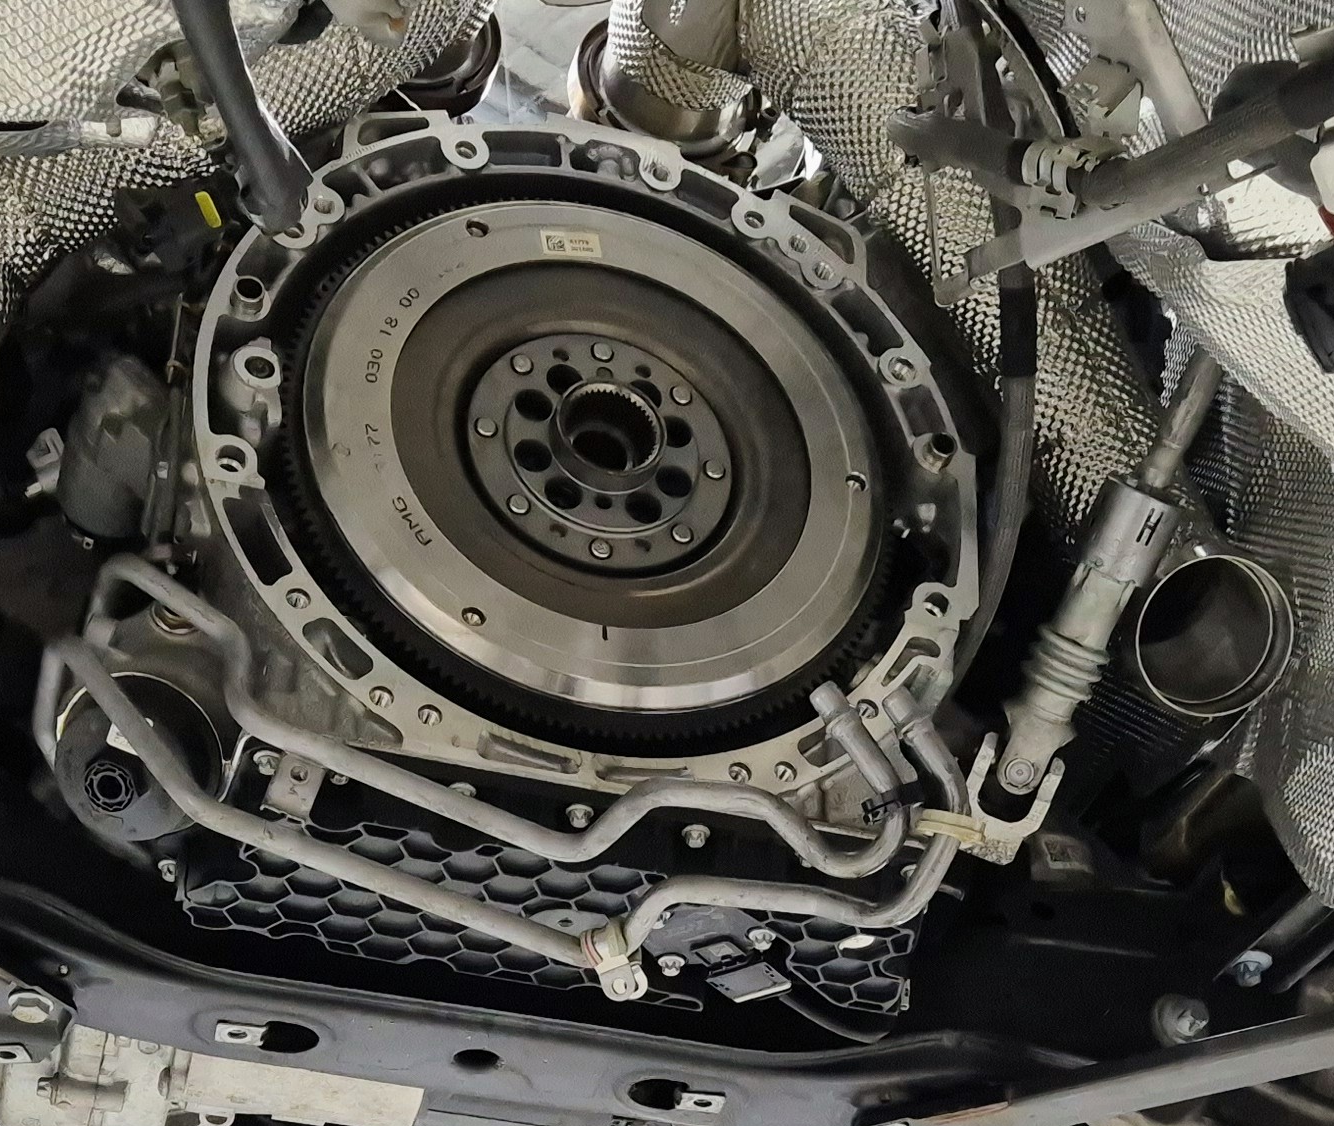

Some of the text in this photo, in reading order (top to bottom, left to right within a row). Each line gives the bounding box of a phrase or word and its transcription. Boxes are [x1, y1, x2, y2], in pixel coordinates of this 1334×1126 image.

[399, 287, 420, 308] 00
[379, 316, 398, 336] 18
[365, 348, 383, 383] 030
[392, 496, 433, 546] AMG
